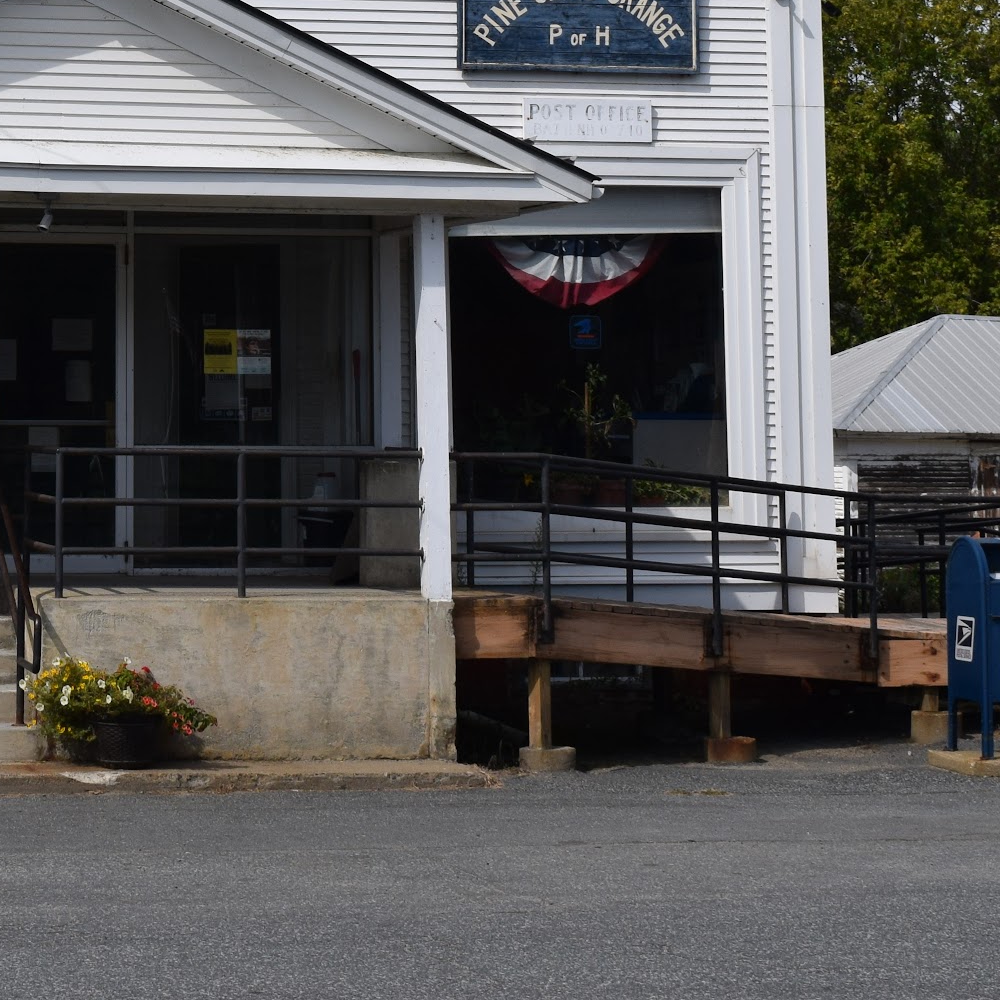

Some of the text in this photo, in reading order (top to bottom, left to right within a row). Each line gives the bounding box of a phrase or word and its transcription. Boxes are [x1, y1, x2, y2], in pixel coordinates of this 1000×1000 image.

[549, 24, 610, 46] P OF H
[529, 103, 646, 122] POST OFFICE
